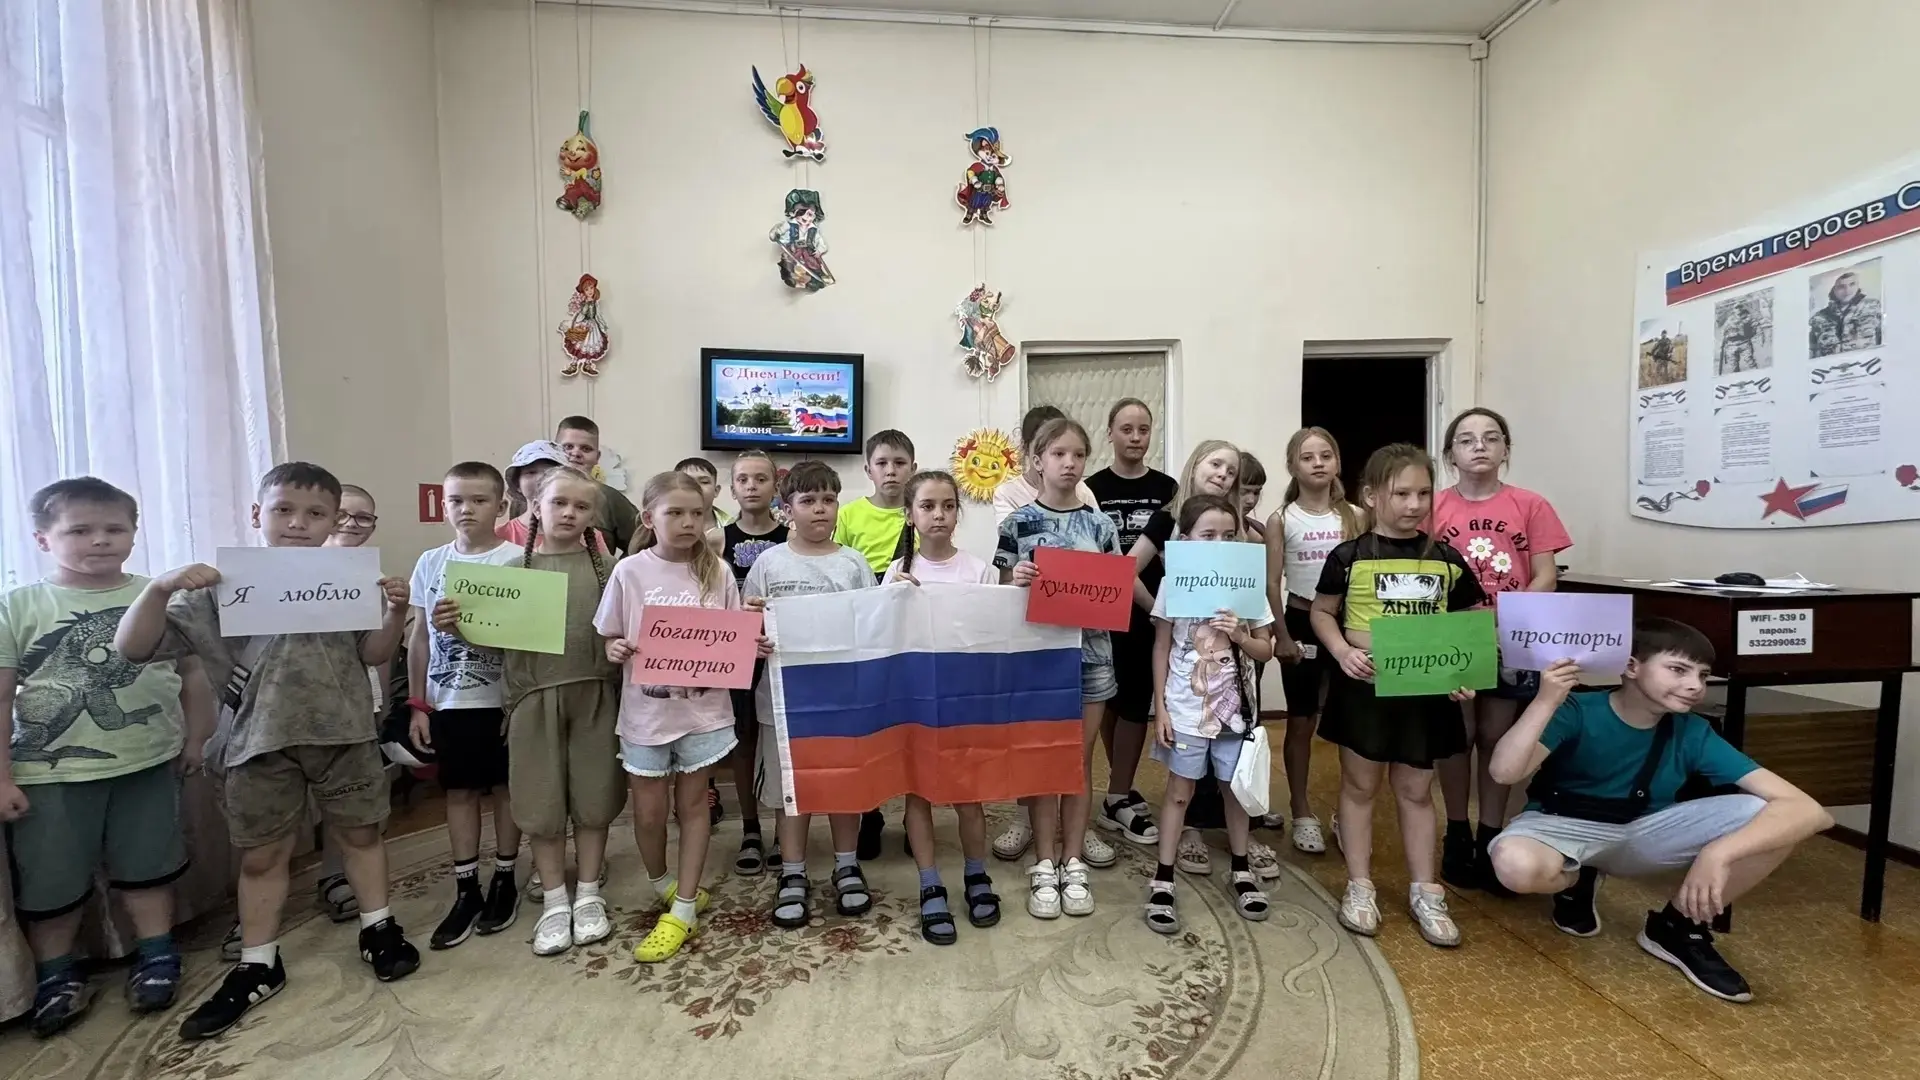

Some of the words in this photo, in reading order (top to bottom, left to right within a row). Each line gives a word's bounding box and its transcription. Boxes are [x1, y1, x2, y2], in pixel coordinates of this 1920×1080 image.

[1679, 241, 1764, 284] Время
[1771, 200, 1887, 254] героев
[722, 367, 734, 378] С
[737, 367, 777, 380] Днем
[783, 369, 840, 381] России!
[724, 424, 737, 434] 12
[739, 425, 772, 435] июня
[1439, 526, 1460, 546] OU
[1469, 518, 1508, 533] ARE
[1510, 531, 1530, 553] MY
[453, 578, 521, 600] Россию
[1039, 579, 1122, 604] культуру
[1174, 569, 1257, 593] традиции
[221, 585, 255, 608] Я
[279, 582, 361, 603] люблю
[1382, 600, 1440, 615] ANIME
[1779, 614, 1797, 622] 539
[1799, 613, 1806, 621] D
[649, 620, 737, 647] богатую
[1510, 629, 1623, 652] просторы
[1759, 627, 1797, 635] пароль:
[644, 657, 736, 678] историю
[1384, 645, 1473, 675] природу
